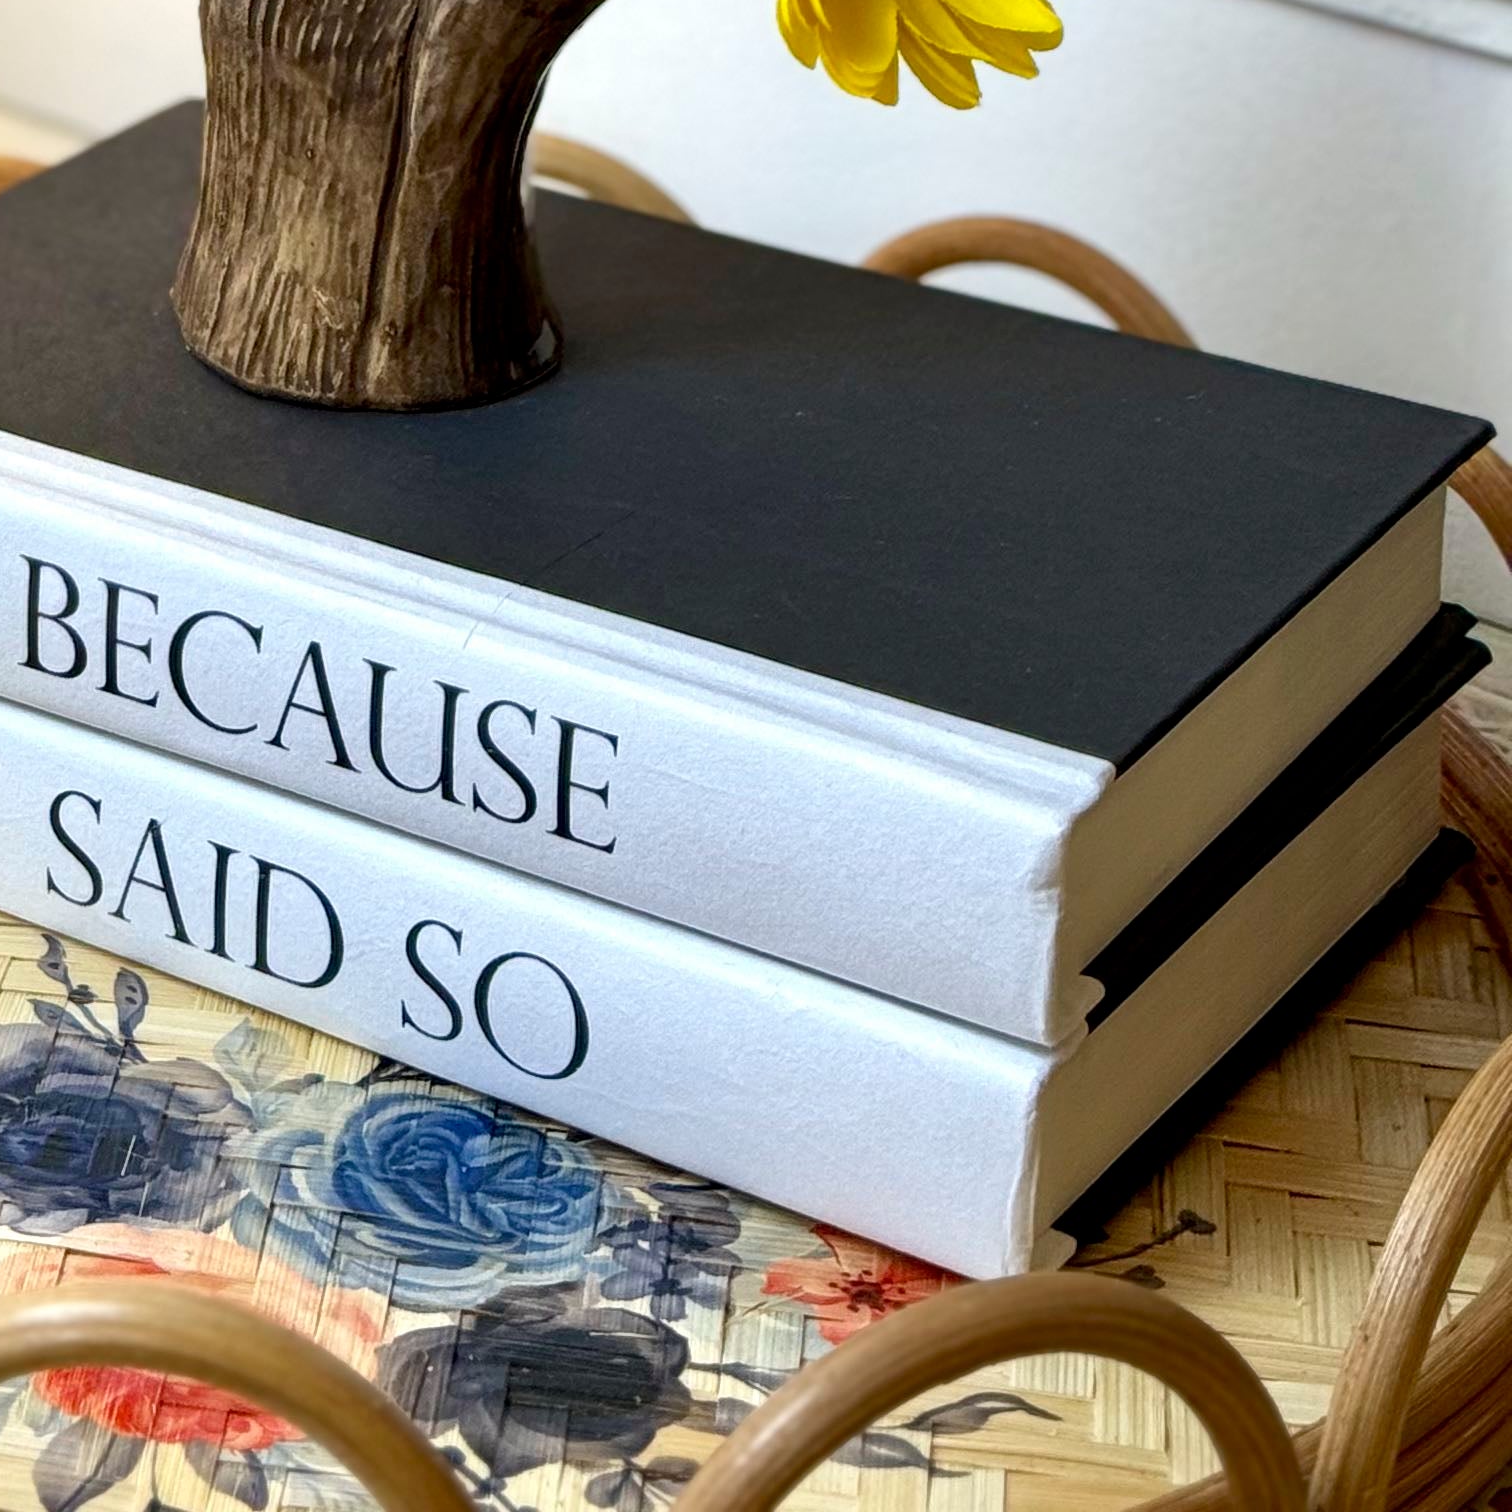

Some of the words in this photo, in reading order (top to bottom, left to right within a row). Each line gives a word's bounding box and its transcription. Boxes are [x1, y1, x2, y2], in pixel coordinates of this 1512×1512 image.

[17, 553, 619, 855] BECAUSE
[45, 789, 346, 989] SAID
[399, 918, 591, 1081] SO
